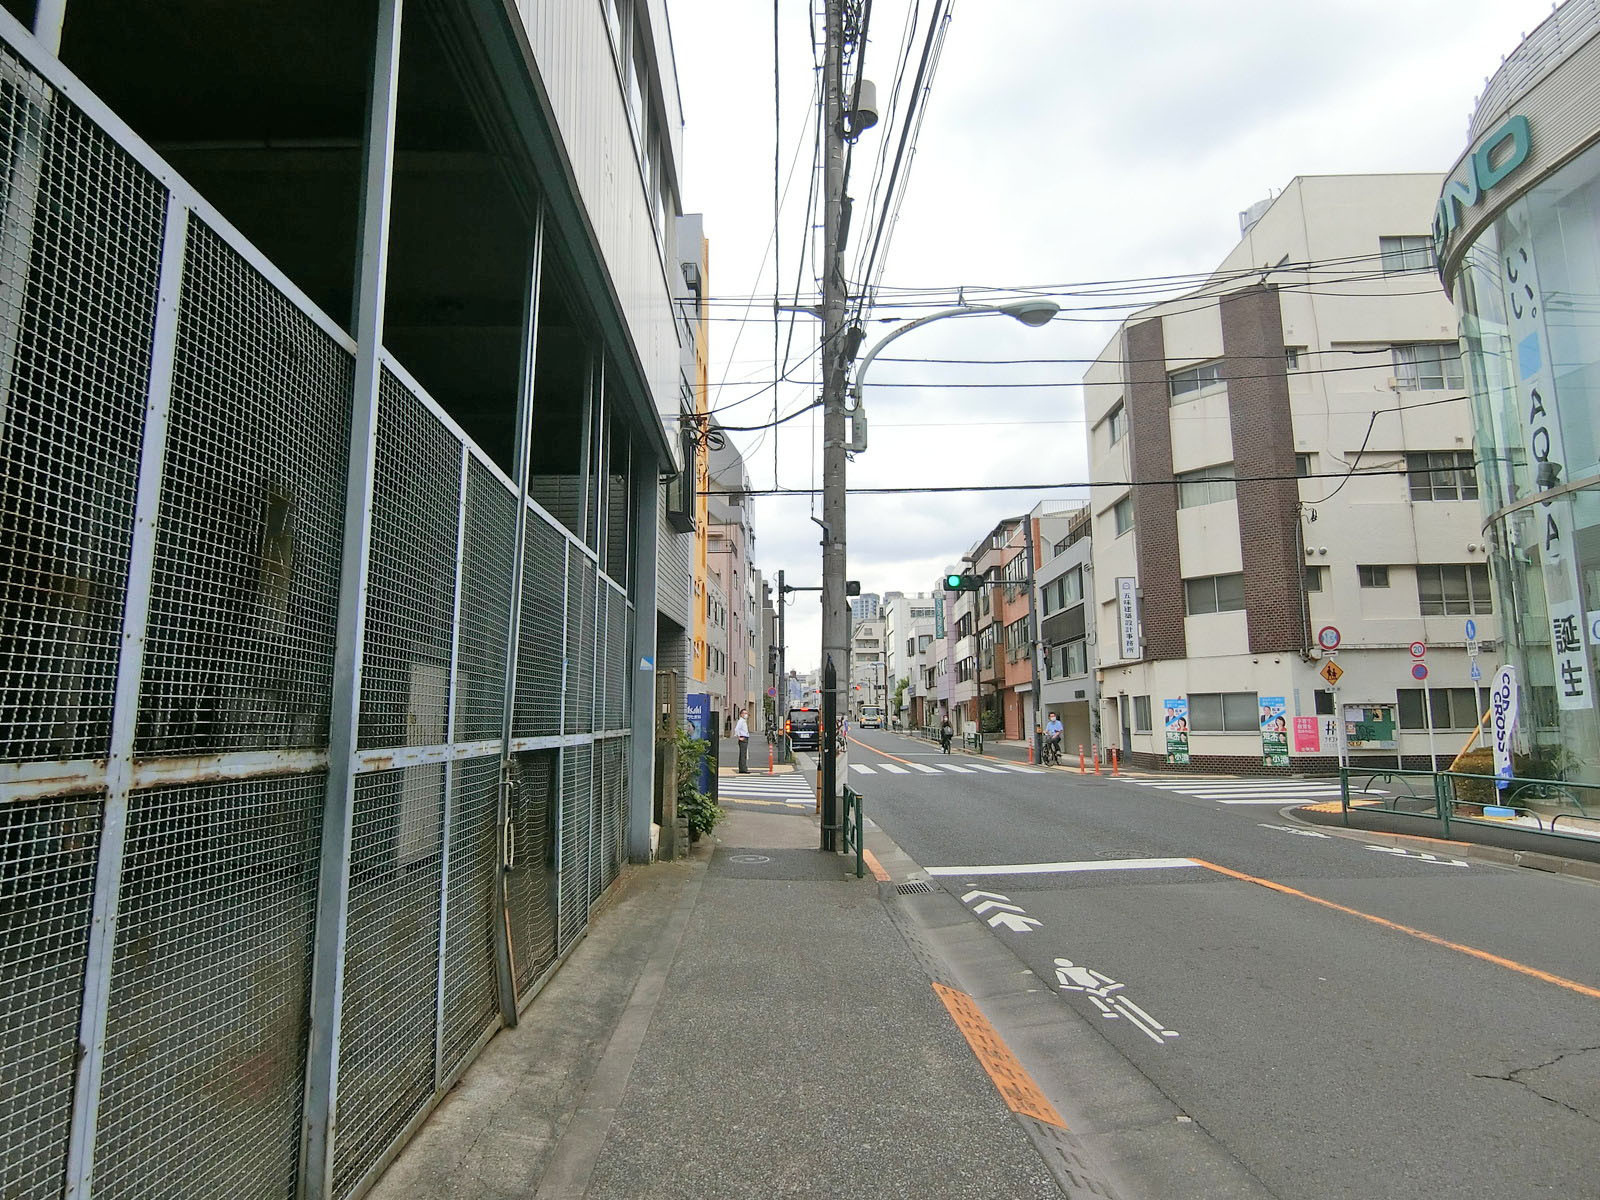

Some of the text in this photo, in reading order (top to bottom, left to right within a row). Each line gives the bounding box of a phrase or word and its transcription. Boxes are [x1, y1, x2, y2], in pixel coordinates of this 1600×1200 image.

[1123, 592, 1135, 654] 五味建築設計事務所
[1413, 645, 1423, 654] 20
[1552, 613, 1584, 697] 誕生
[1493, 691, 1506, 753] CROSS
